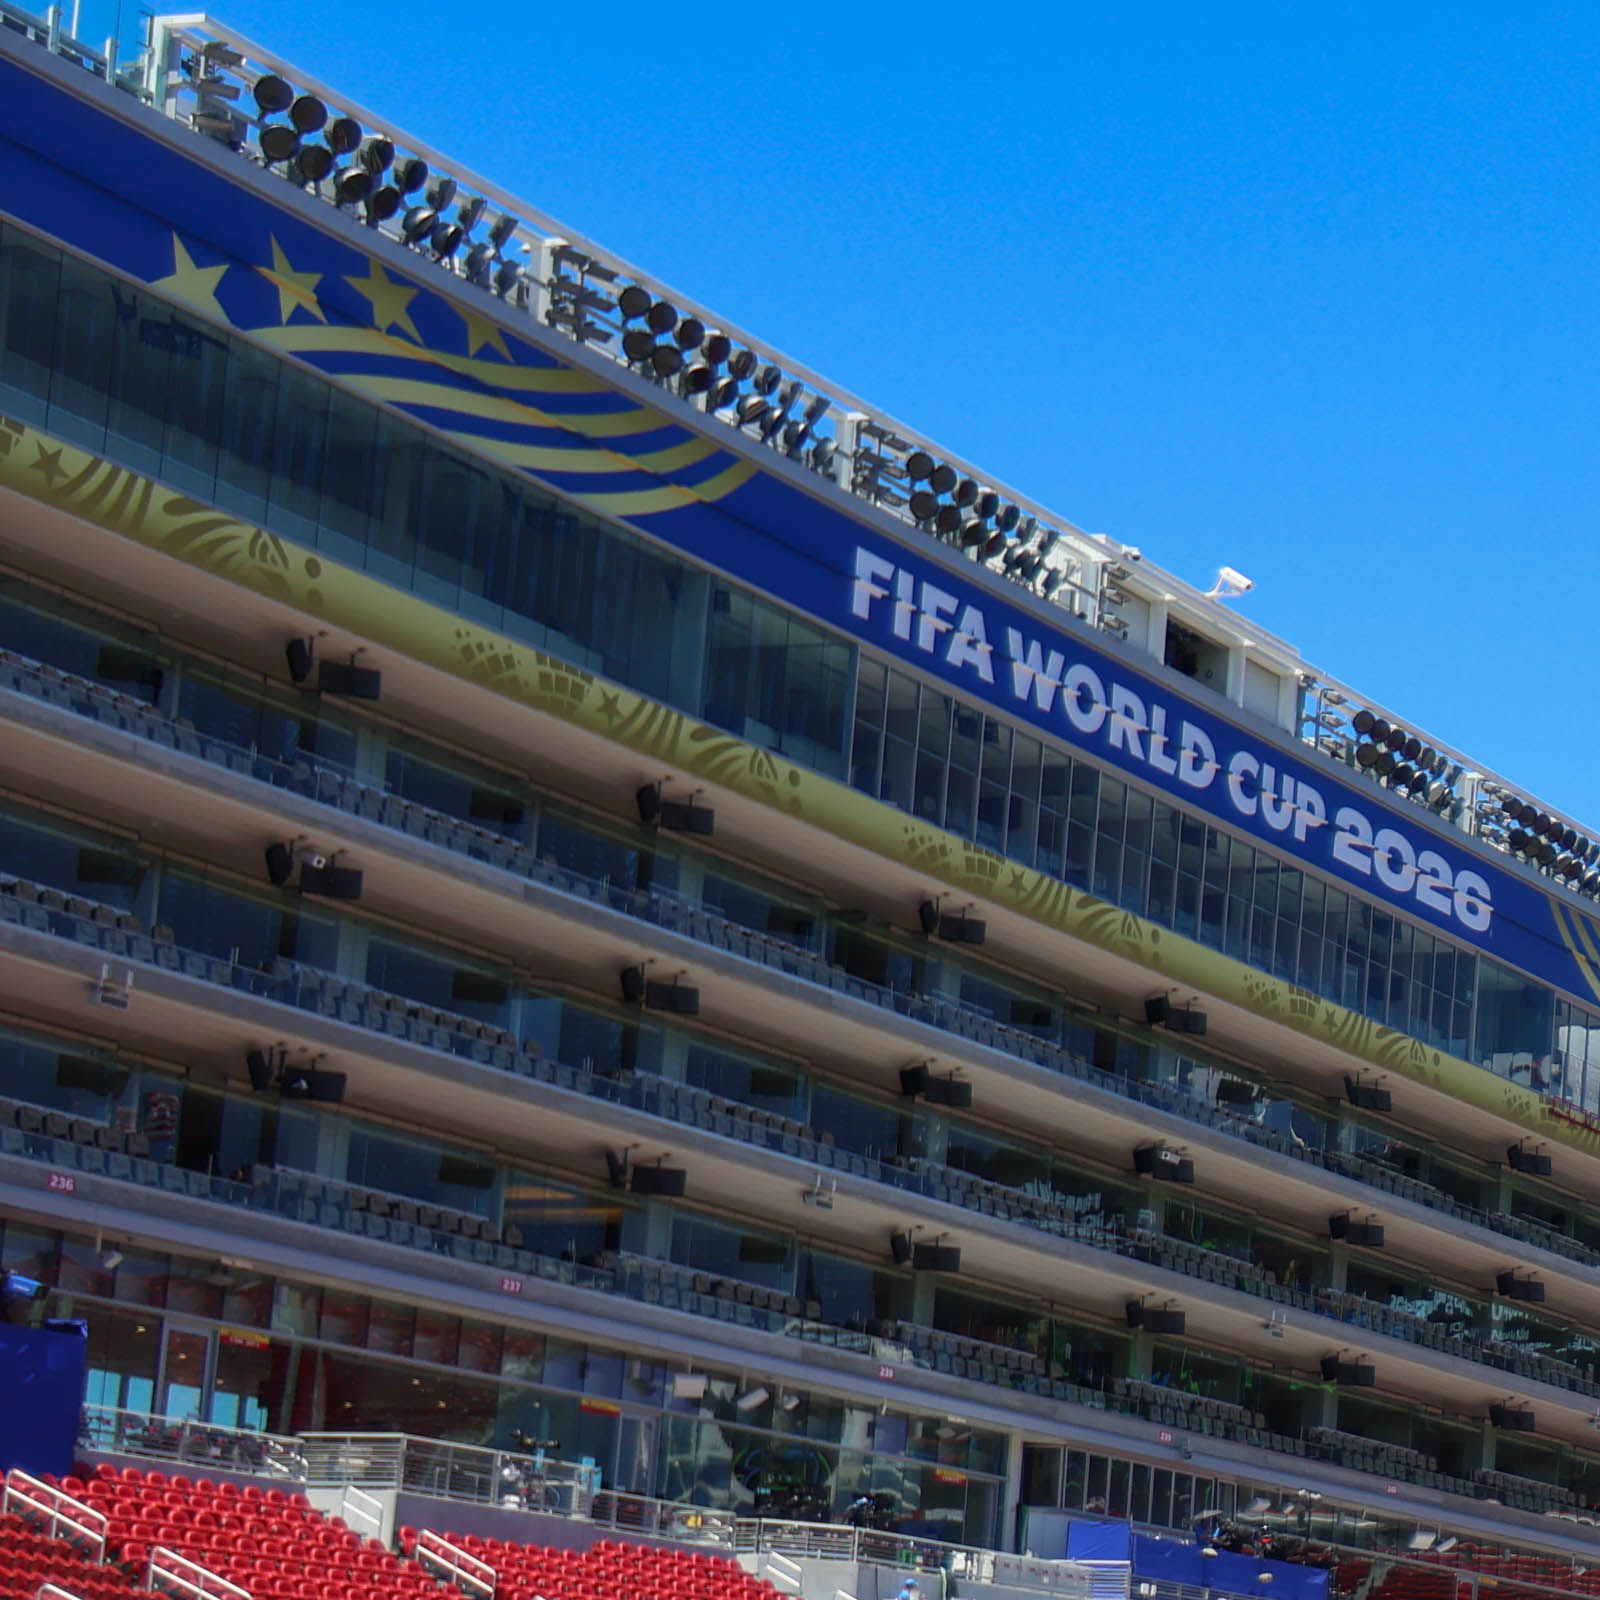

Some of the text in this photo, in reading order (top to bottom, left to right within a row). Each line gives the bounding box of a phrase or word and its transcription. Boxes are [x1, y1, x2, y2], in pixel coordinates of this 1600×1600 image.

[850, 546, 1492, 932] FIFA WORLD CUP 2026
[51, 1175, 74, 1190] 236
[503, 1279, 520, 1292] 237
